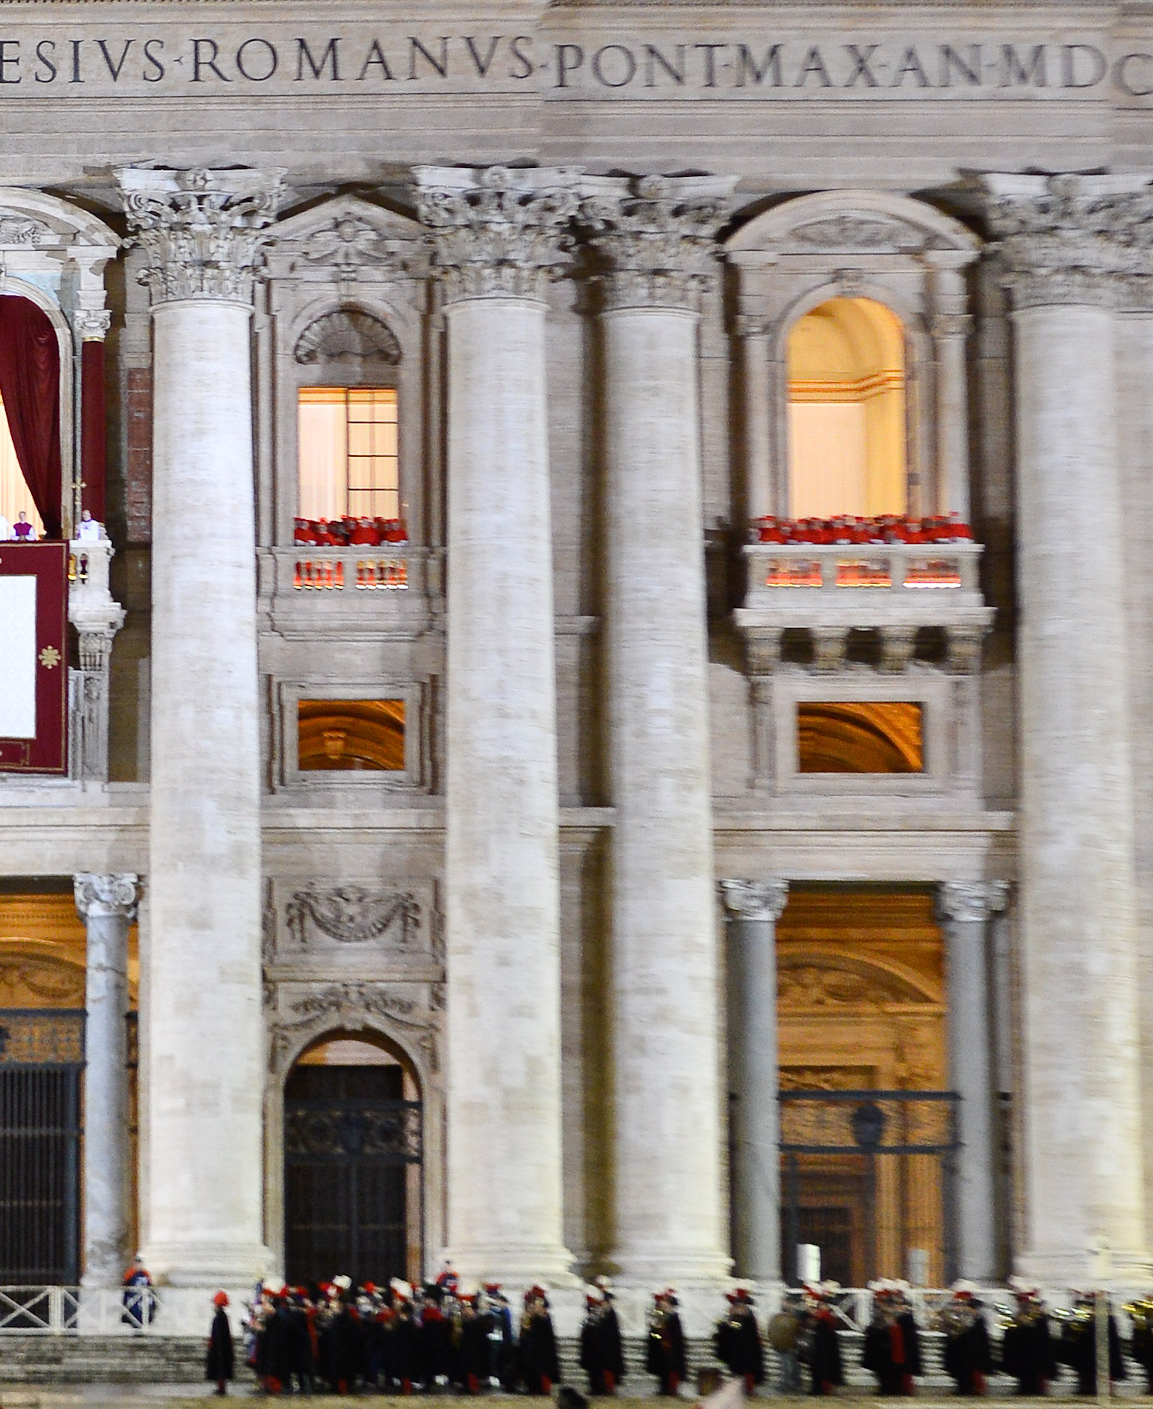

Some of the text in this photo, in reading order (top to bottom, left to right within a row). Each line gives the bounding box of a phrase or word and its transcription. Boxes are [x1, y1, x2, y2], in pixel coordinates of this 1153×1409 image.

[188, 35, 535, 83] ROMANVS
[552, 42, 727, 89] PONT
[733, 43, 882, 88] MAX
[888, 43, 984, 88] AN
